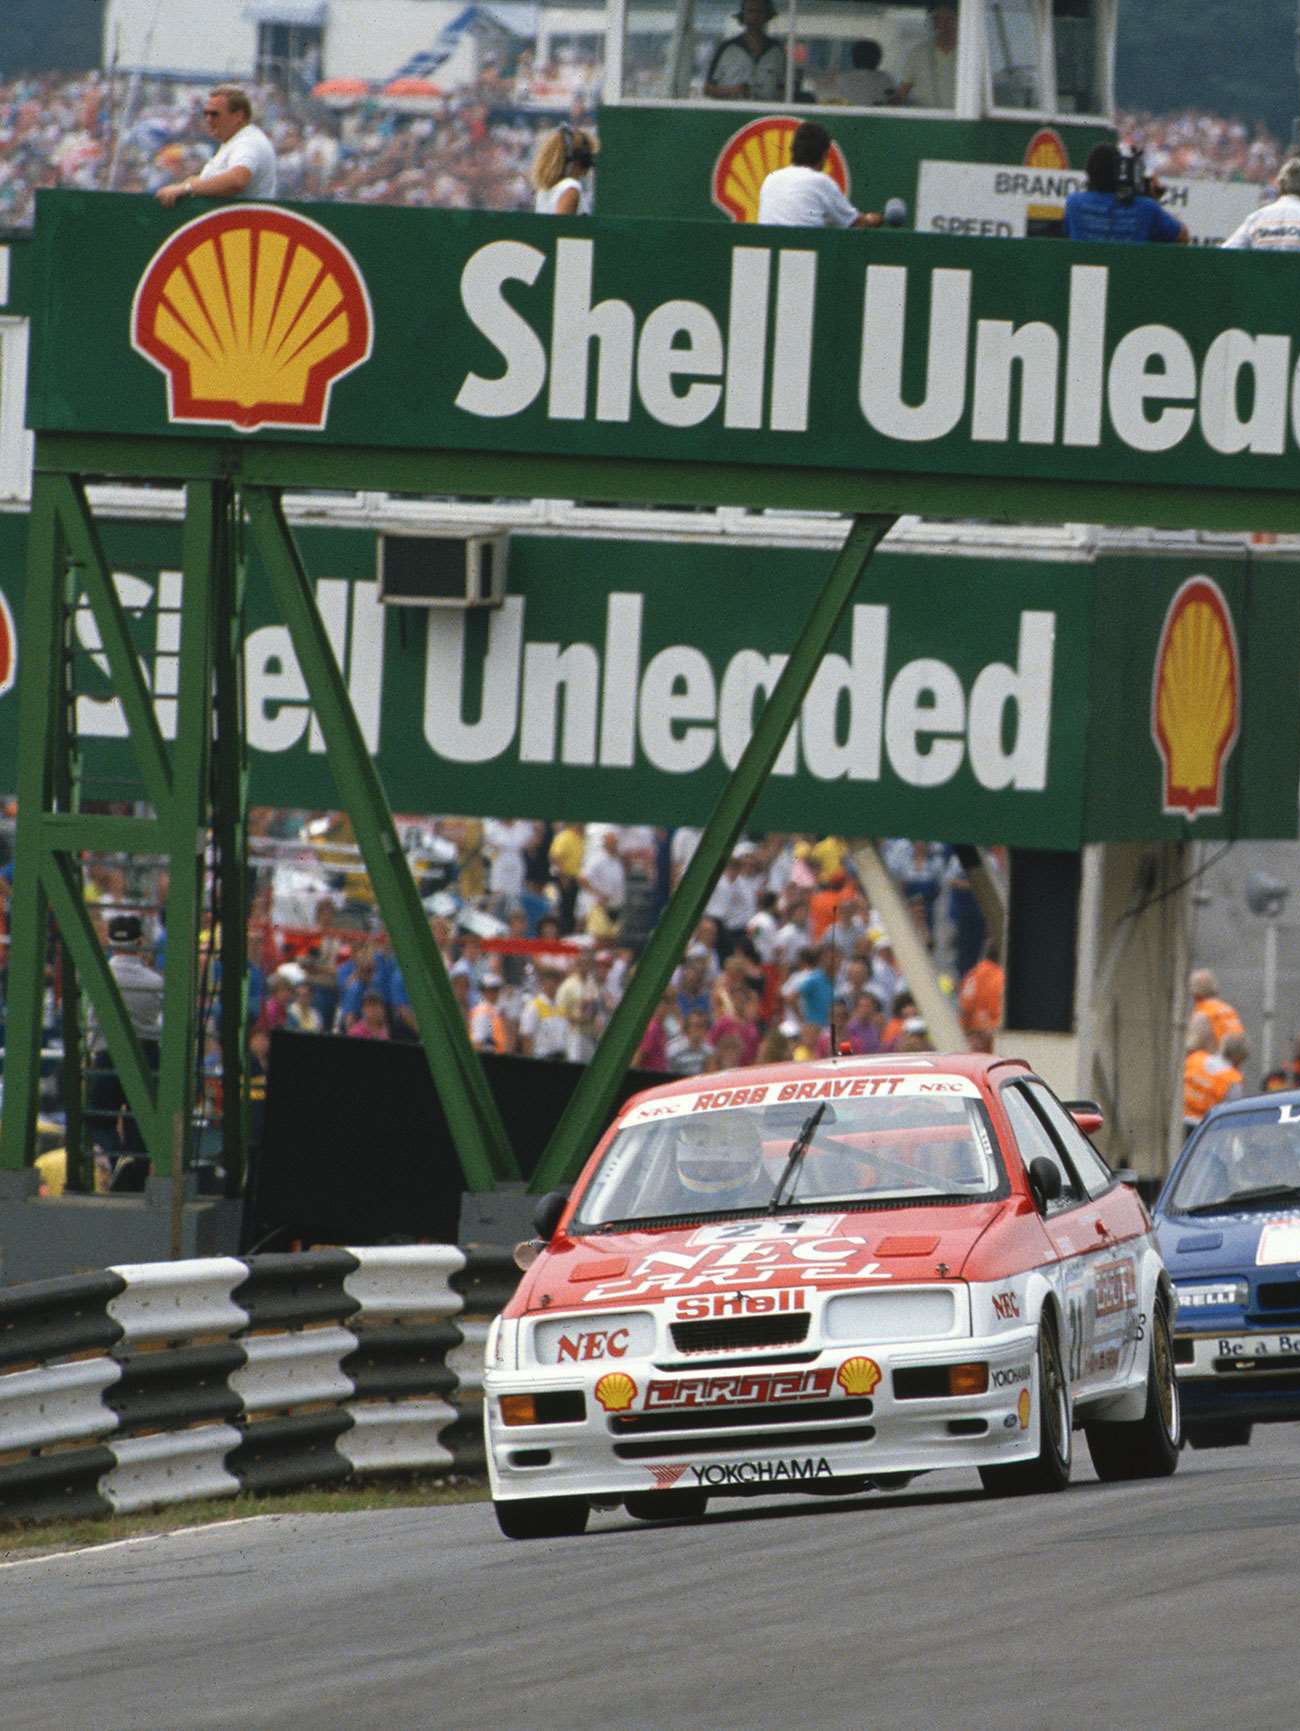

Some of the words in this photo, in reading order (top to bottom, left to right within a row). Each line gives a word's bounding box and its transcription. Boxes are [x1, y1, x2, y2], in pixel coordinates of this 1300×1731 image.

[995, 172, 1088, 197] BRAND
[931, 215, 1013, 238] SPEED
[454, 237, 817, 432] Shell
[424, 592, 1055, 792] Unleaded
[637, 1104, 680, 1119] NEC
[692, 1087, 768, 1111] ROBB
[919, 1083, 963, 1093] NEC
[719, 1221, 805, 1238] 21
[632, 1237, 867, 1277] NEC
[583, 1262, 893, 1301] CARTEL
[1177, 1284, 1238, 1307] RELLI
[676, 1290, 805, 1320] Shell
[992, 1291, 1020, 1320] NEC
[556, 1328, 630, 1364] NEC
[1218, 1339, 1244, 1356] Be
[1255, 1342, 1269, 1355] a
[648, 1369, 832, 1407] CARTEL
[691, 1457, 833, 1486] YOKOHAMA
